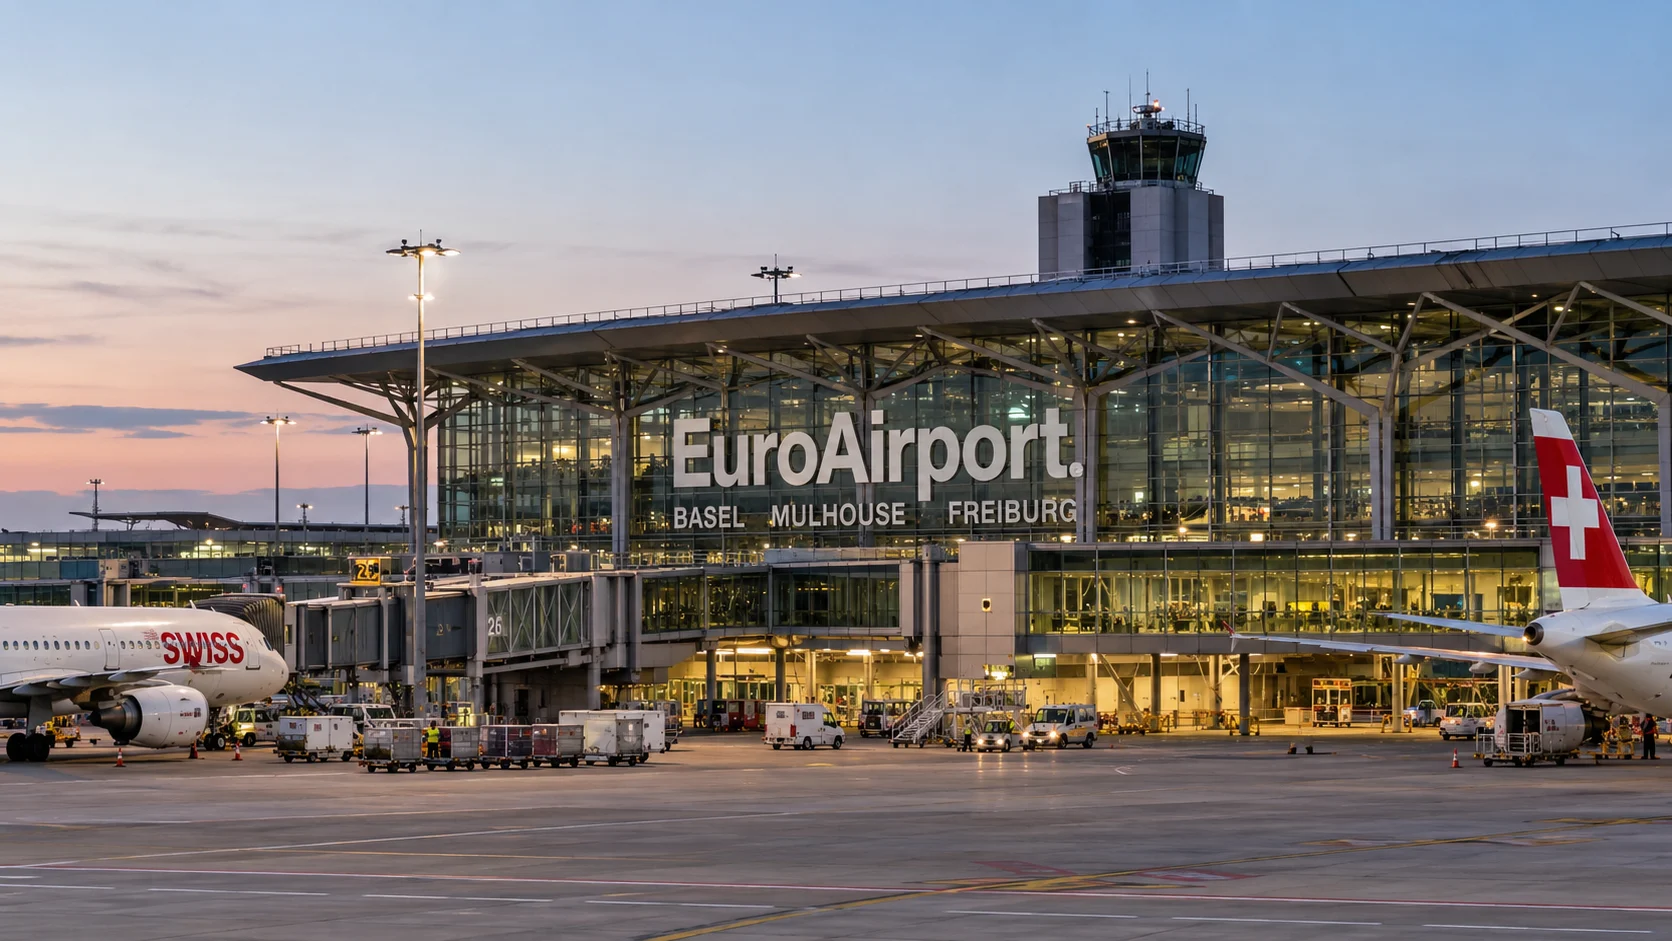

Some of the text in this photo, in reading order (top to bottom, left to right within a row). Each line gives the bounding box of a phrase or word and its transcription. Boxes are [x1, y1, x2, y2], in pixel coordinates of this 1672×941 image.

[673, 498, 1077, 529] BASEL MULHOUSE FREIBURG
[487, 615, 503, 636] 26
[160, 632, 245, 665] SWISS
